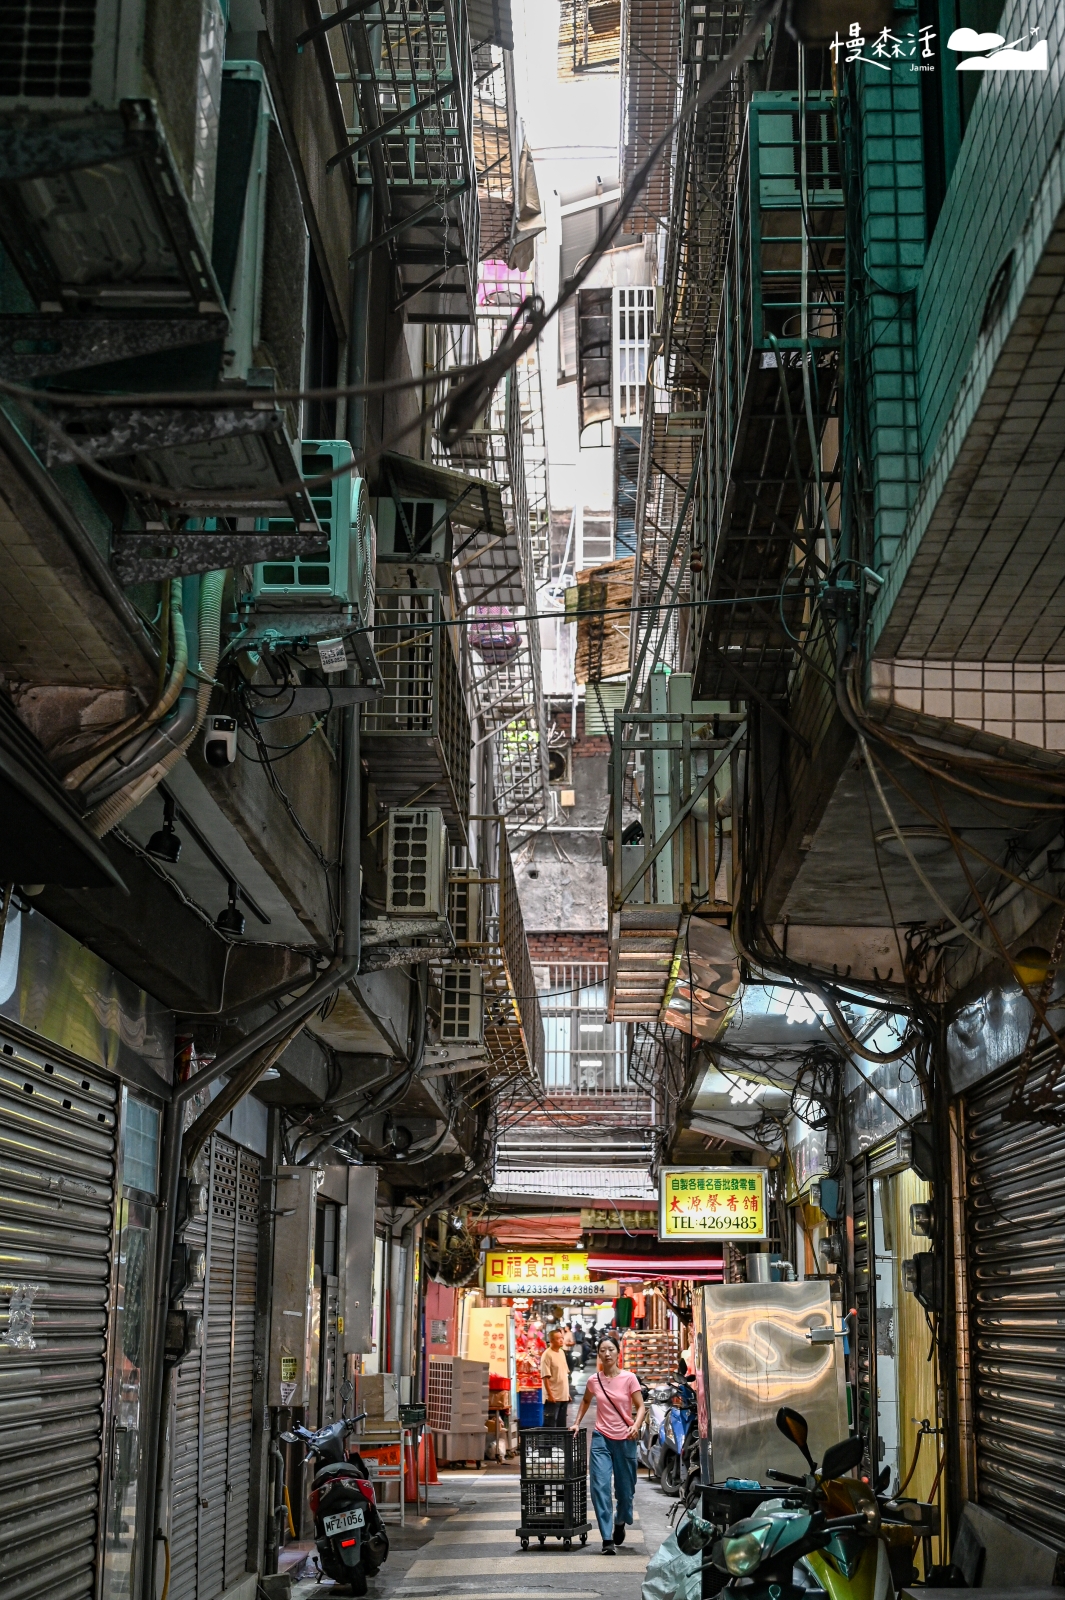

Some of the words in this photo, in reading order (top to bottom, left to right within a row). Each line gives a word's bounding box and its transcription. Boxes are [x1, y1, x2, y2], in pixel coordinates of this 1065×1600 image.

[671, 1178, 756, 1191] 自製各種名香批發零售
[491, 1256, 556, 1278] 口福食品
